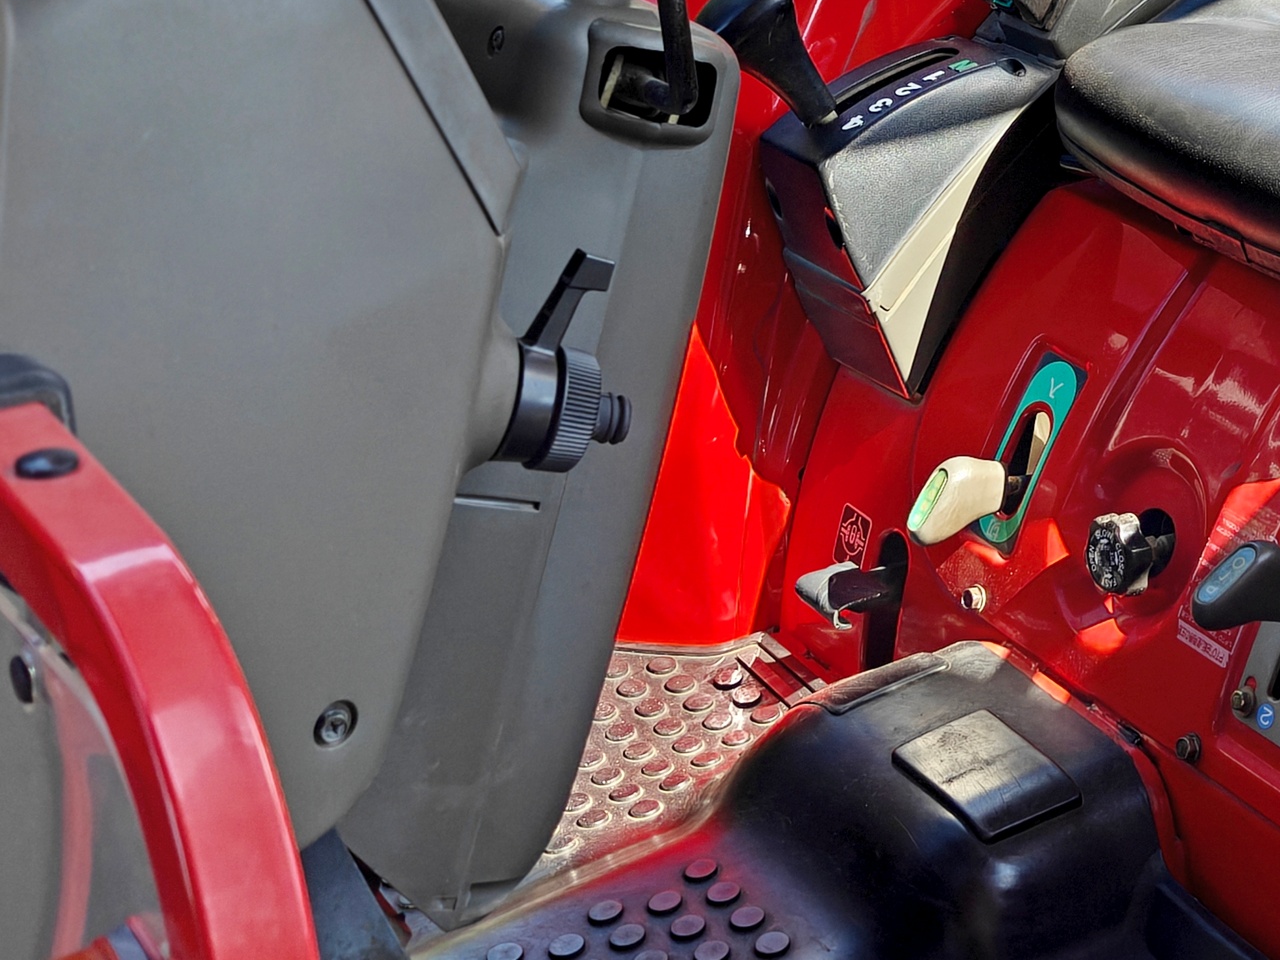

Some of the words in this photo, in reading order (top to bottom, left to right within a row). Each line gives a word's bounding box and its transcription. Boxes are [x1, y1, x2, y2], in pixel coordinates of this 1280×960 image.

[948, 58, 977, 72] N
[922, 70, 945, 82] 1
[895, 82, 922, 96] 2
[868, 97, 893, 113] 3
[841, 114, 864, 131] 4
[1088, 544, 1097, 572] OPEN
[1260, 706, 1273, 726] 2
